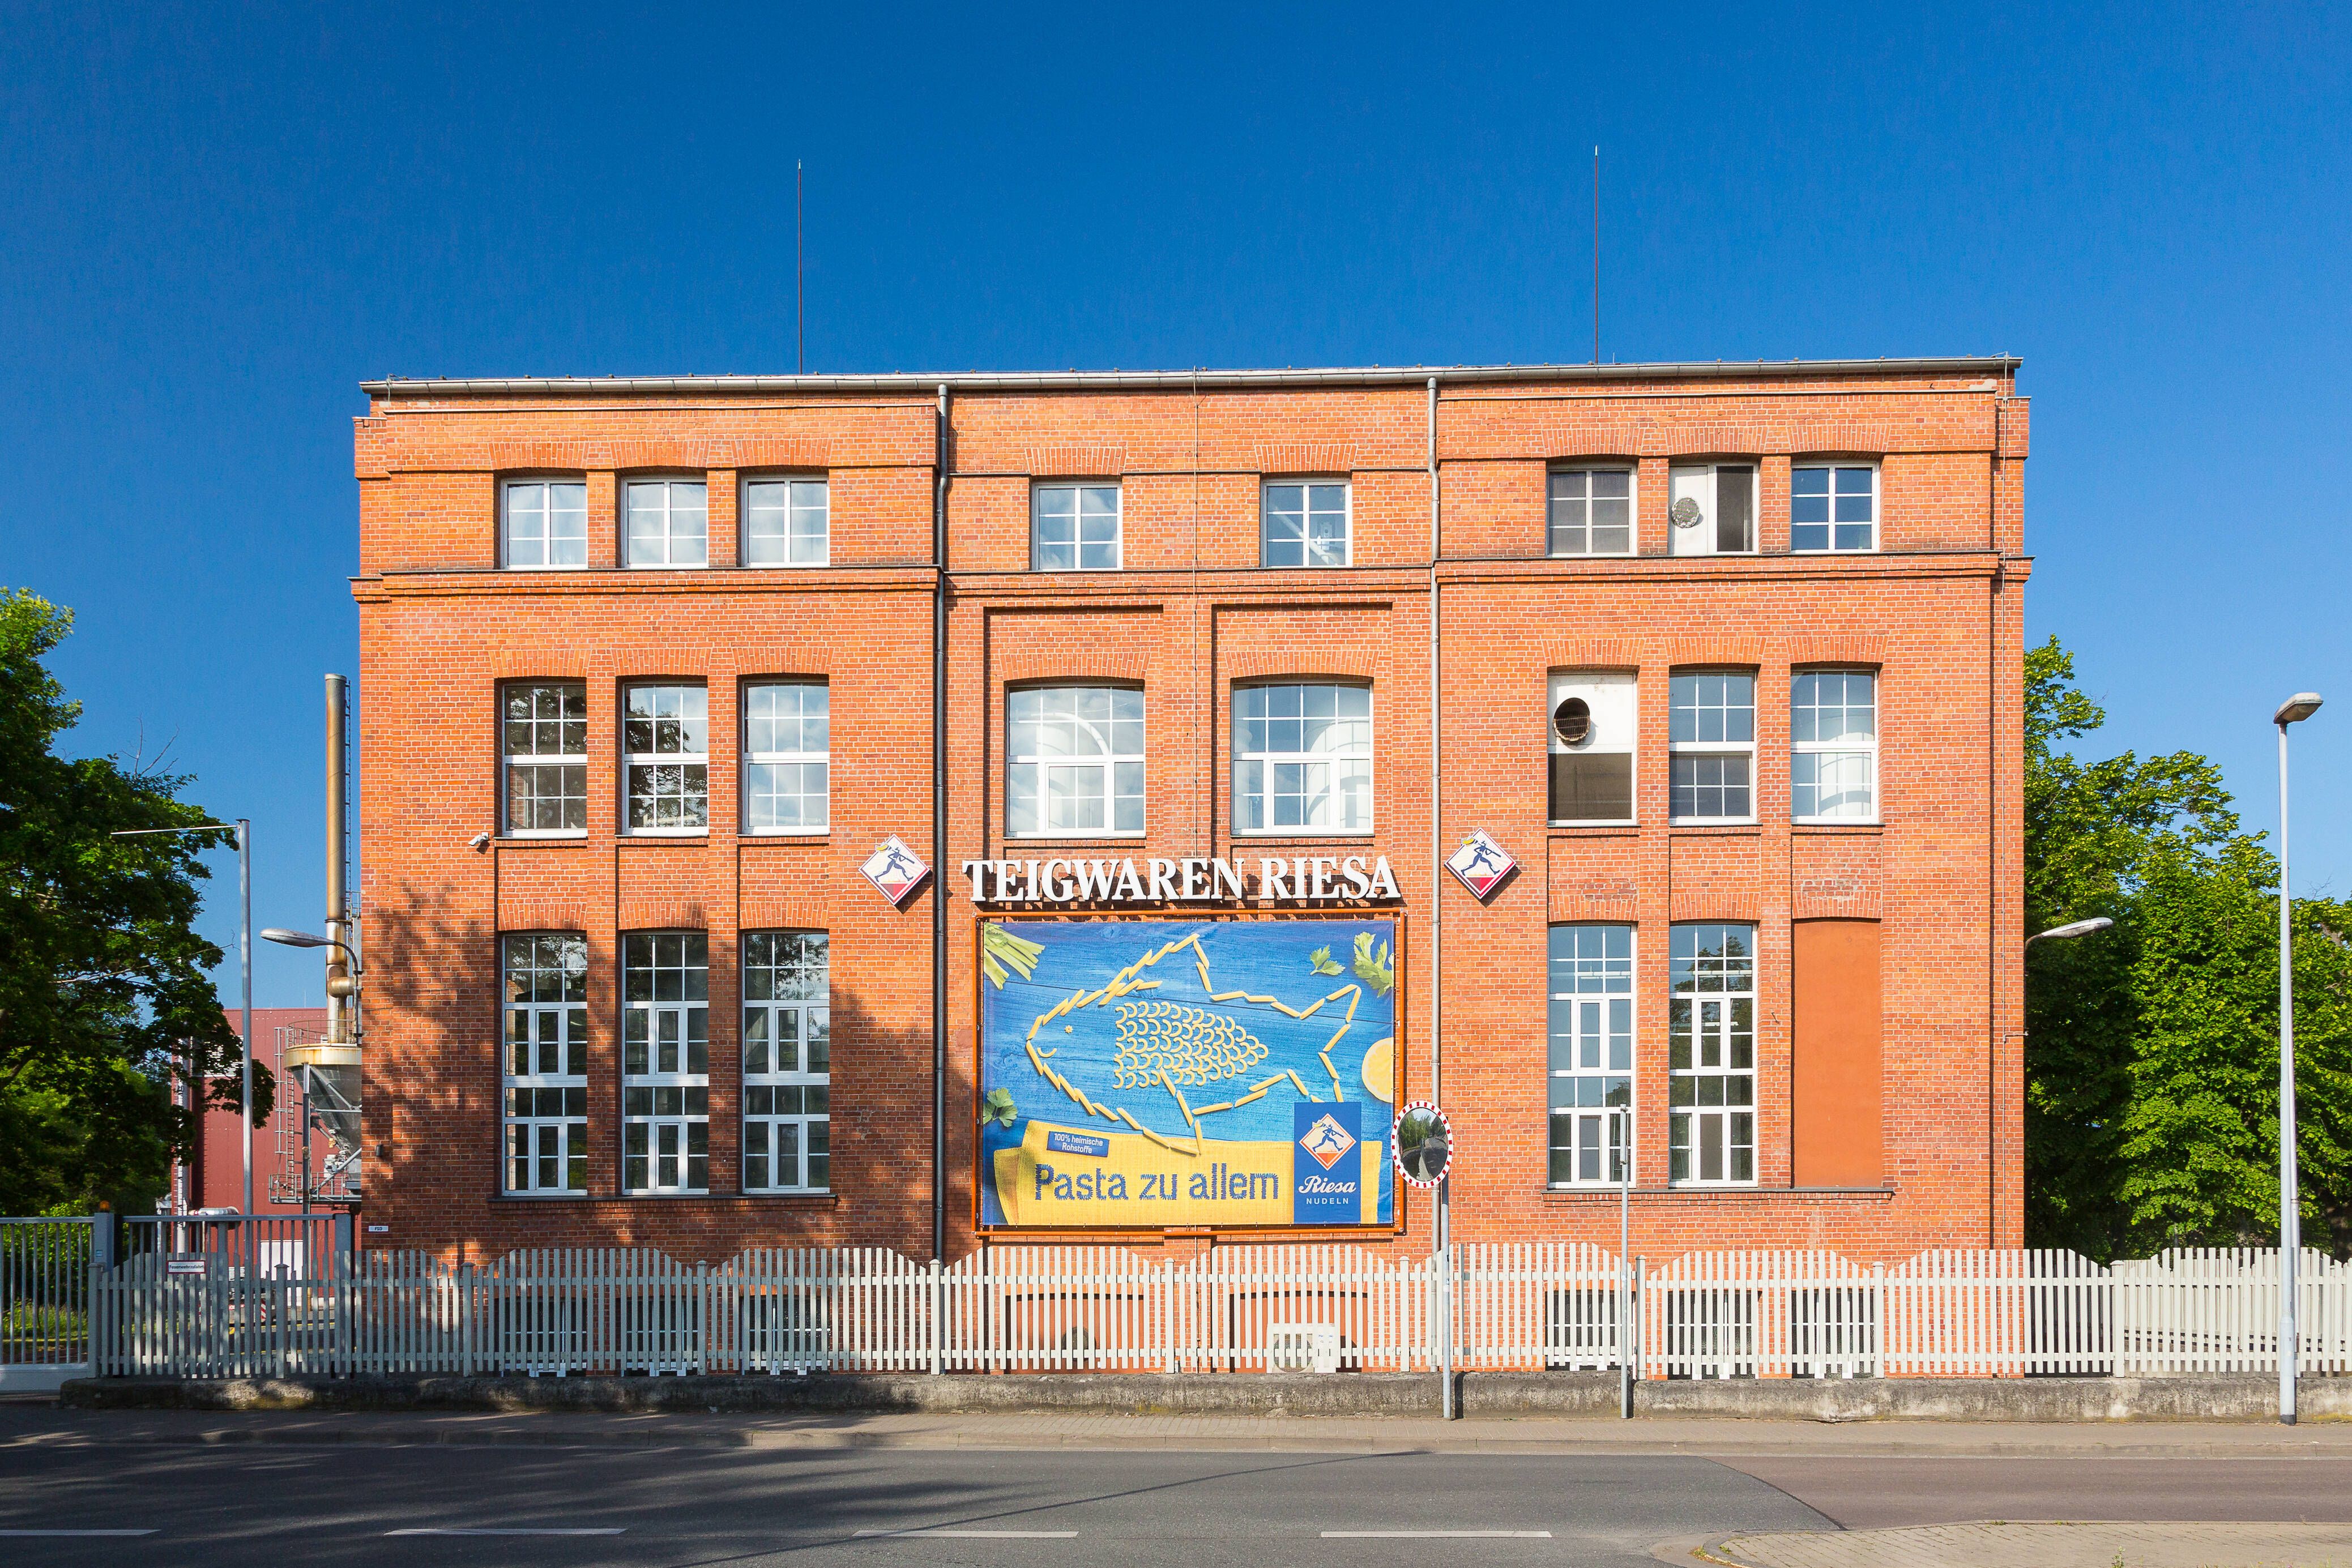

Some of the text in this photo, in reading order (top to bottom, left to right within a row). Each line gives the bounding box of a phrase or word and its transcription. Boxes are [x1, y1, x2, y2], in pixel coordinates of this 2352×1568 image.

[962, 855, 1402, 902] TEIGWAREN RIESA
[1054, 1133, 1103, 1146] 100% heimische
[1062, 1142, 1092, 1153] Rohstoffe
[1035, 1163, 1279, 1200] Pasta zu allem
[1298, 1174, 1356, 1194] Riesa
